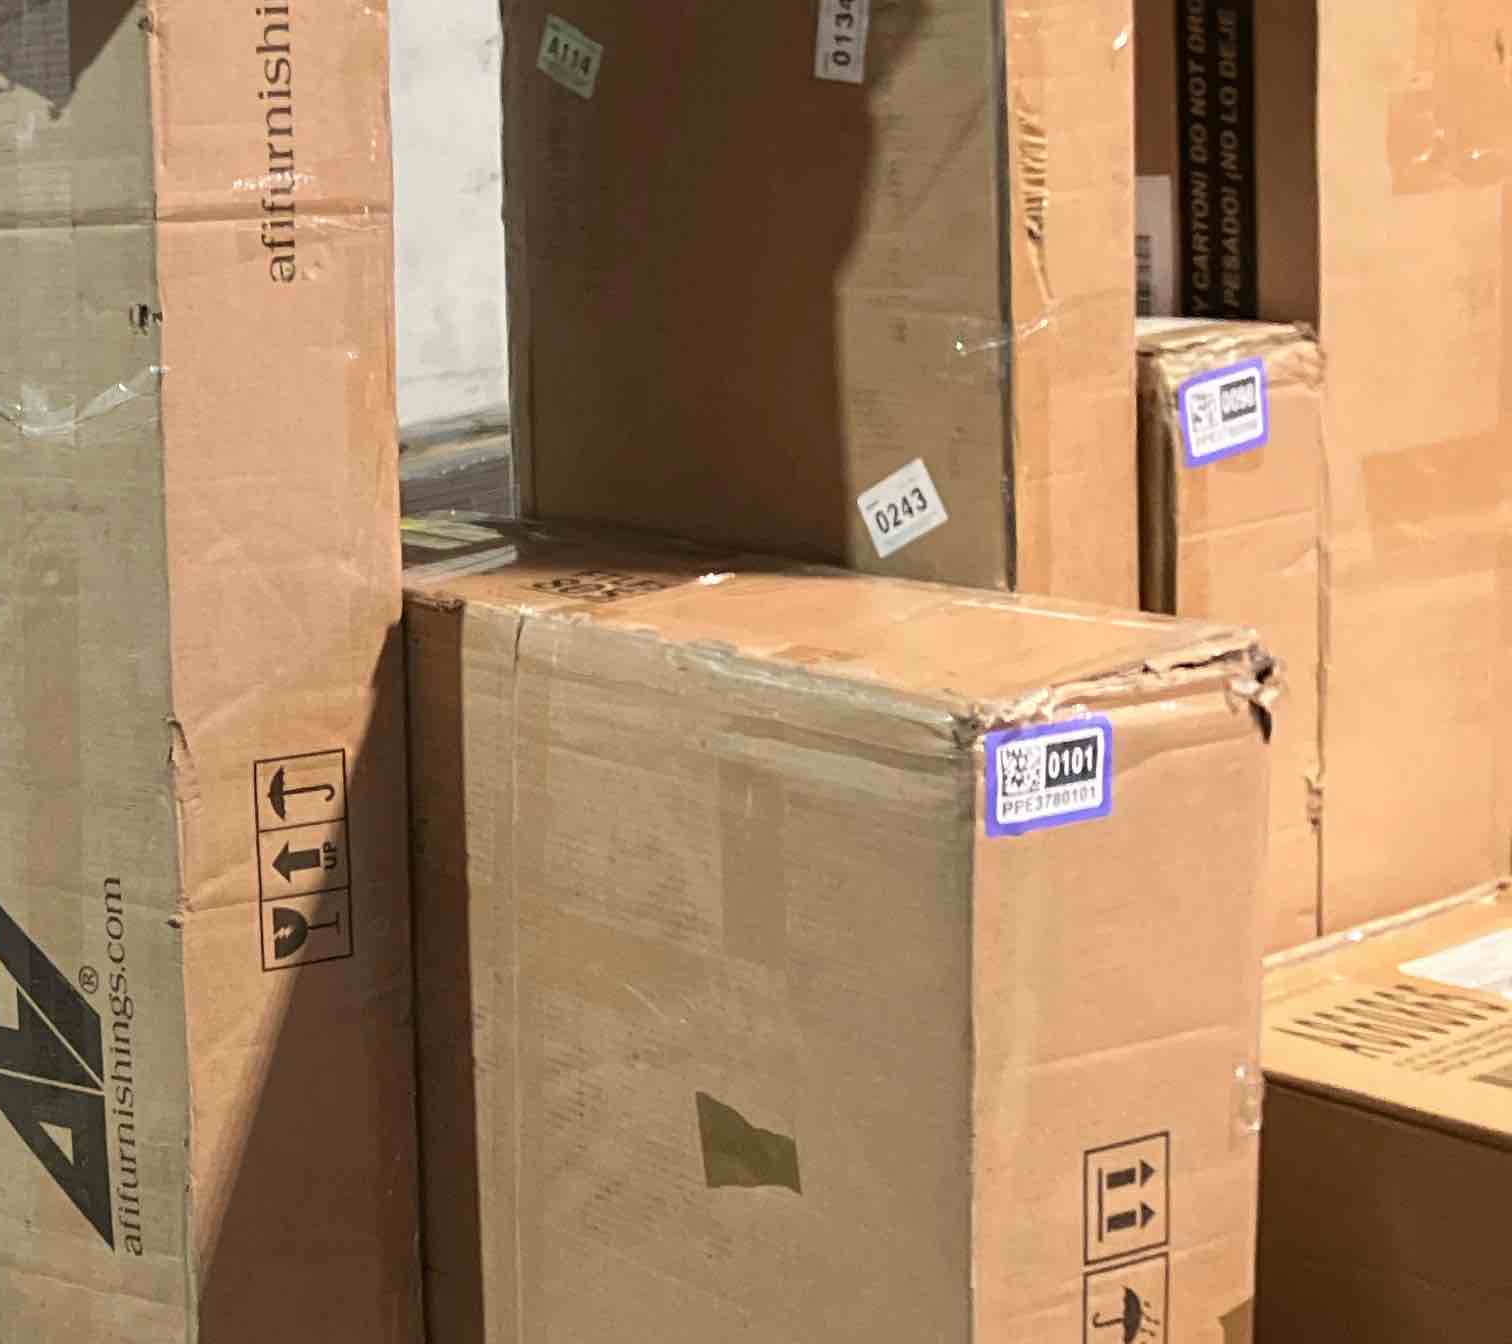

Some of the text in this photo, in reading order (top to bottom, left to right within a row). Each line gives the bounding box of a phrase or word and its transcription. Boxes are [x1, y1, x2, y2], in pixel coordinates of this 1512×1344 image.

[1187, 60, 1207, 119] NOT
[875, 487, 928, 534] 0243
[1048, 744, 1094, 778] 0101
[323, 840, 339, 871] UP
[102, 875, 144, 1258] afifurnishings.com
